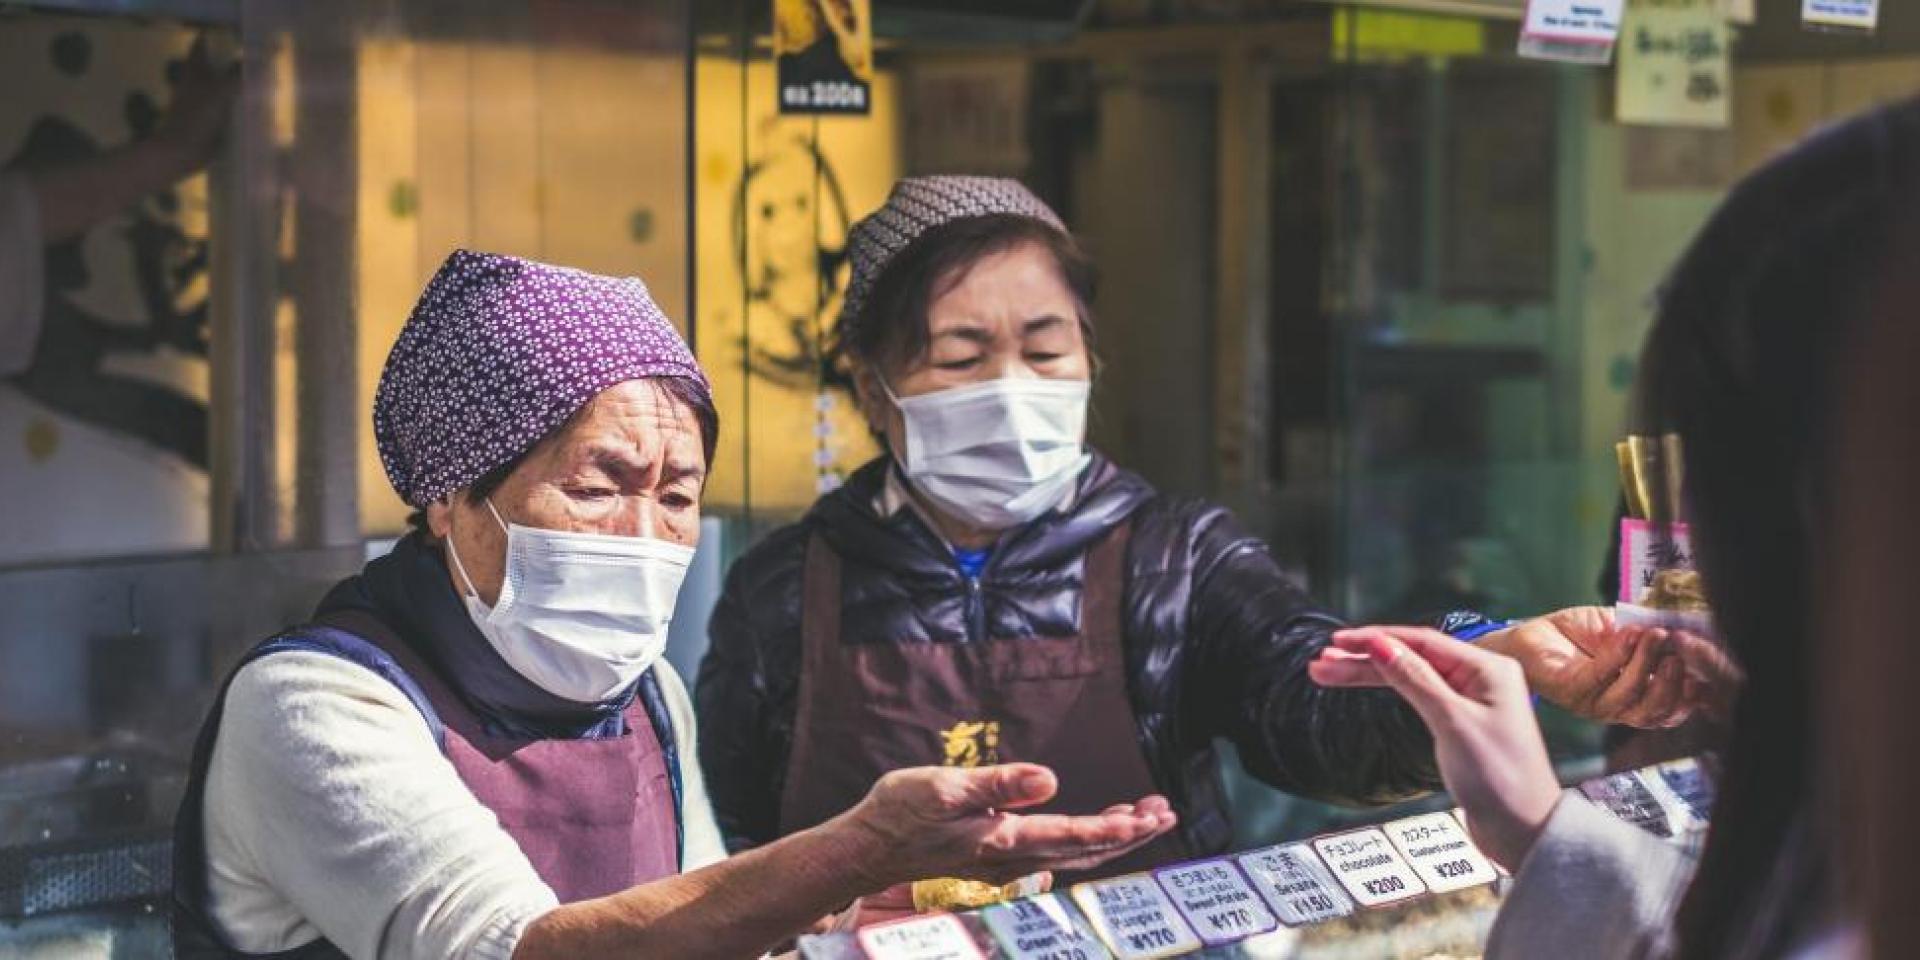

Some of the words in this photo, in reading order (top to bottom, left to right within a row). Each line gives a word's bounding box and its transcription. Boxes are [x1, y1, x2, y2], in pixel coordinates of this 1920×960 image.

[1401, 823, 1449, 842] カスタード
[1323, 836, 1383, 859] チョコレート
[1339, 853, 1394, 873] chocolate
[1434, 858, 1474, 879] ¥200
[1361, 874, 1406, 897] ¥200
[1207, 908, 1252, 930] ¥170
[1127, 927, 1177, 950] ¥170
